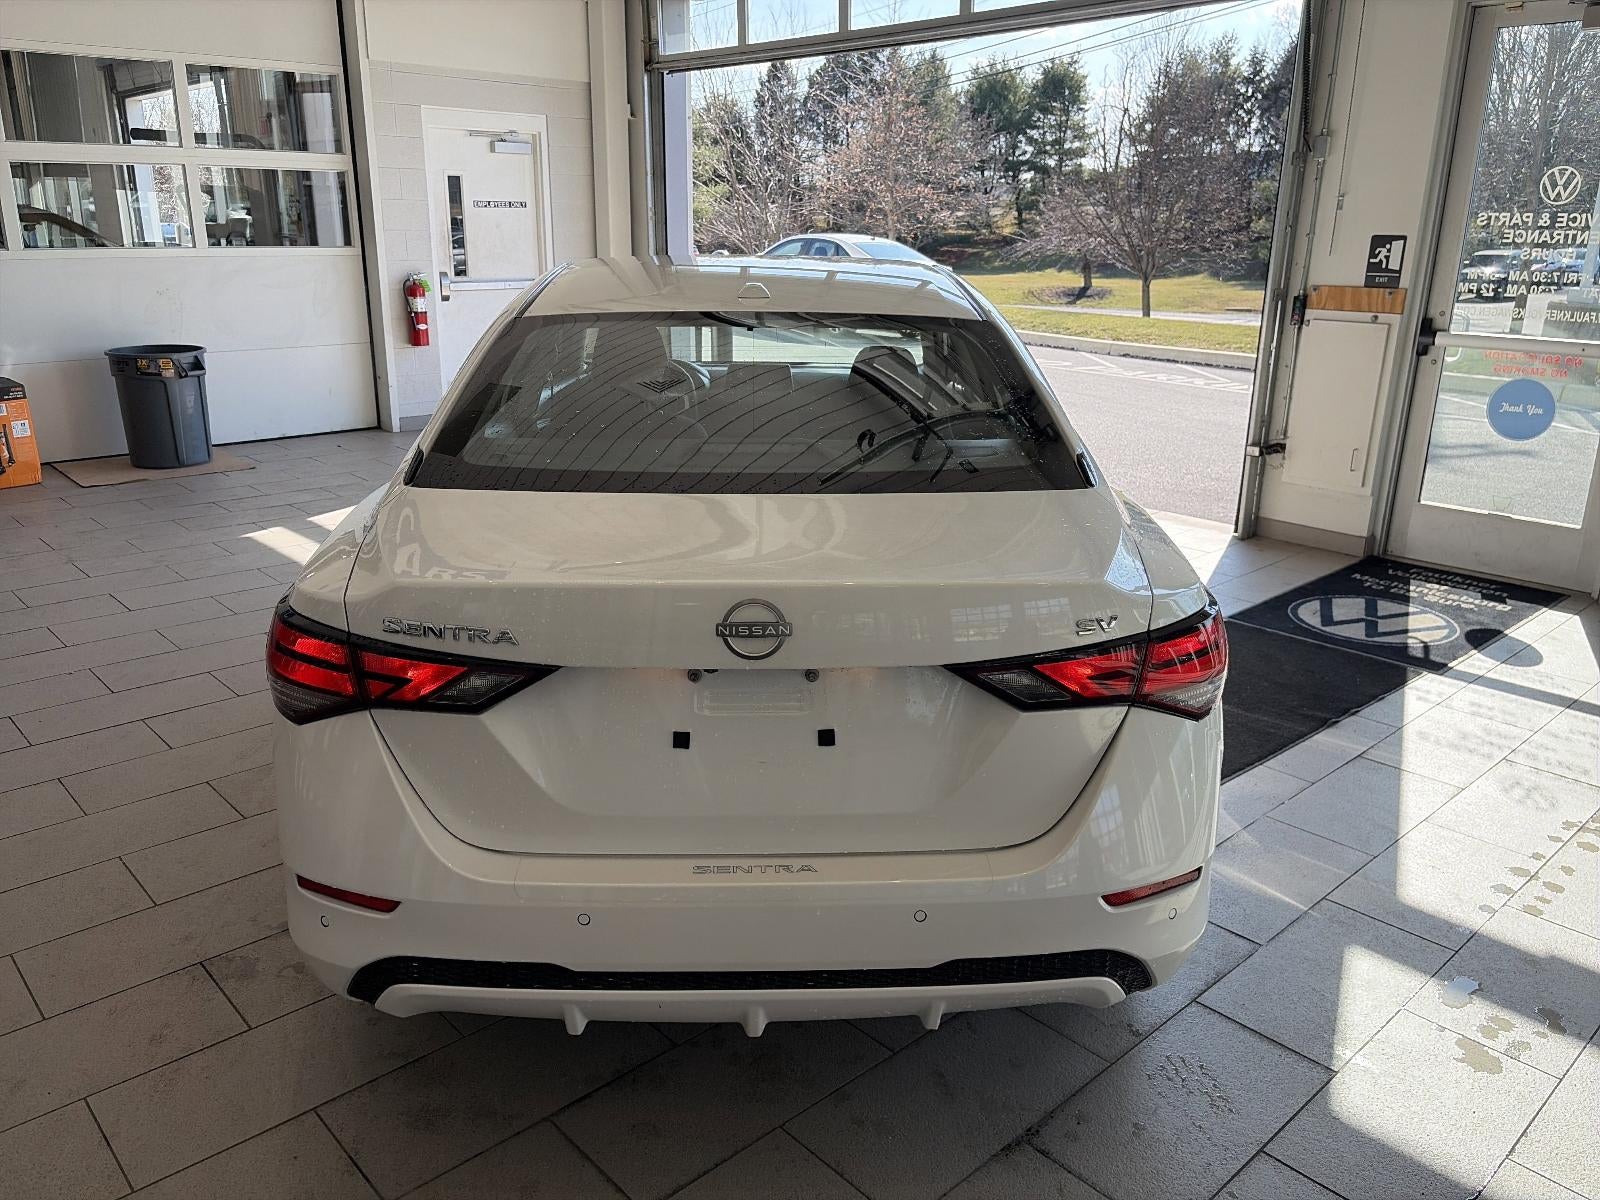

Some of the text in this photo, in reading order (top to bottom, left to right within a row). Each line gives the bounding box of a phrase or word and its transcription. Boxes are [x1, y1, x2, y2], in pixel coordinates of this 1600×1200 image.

[1499, 402, 1544, 415] Thank You
[382, 616, 519, 646] SENTRA
[718, 625, 791, 635] NISSAN
[1075, 615, 1119, 637] SV
[692, 864, 818, 875] SENTRA
